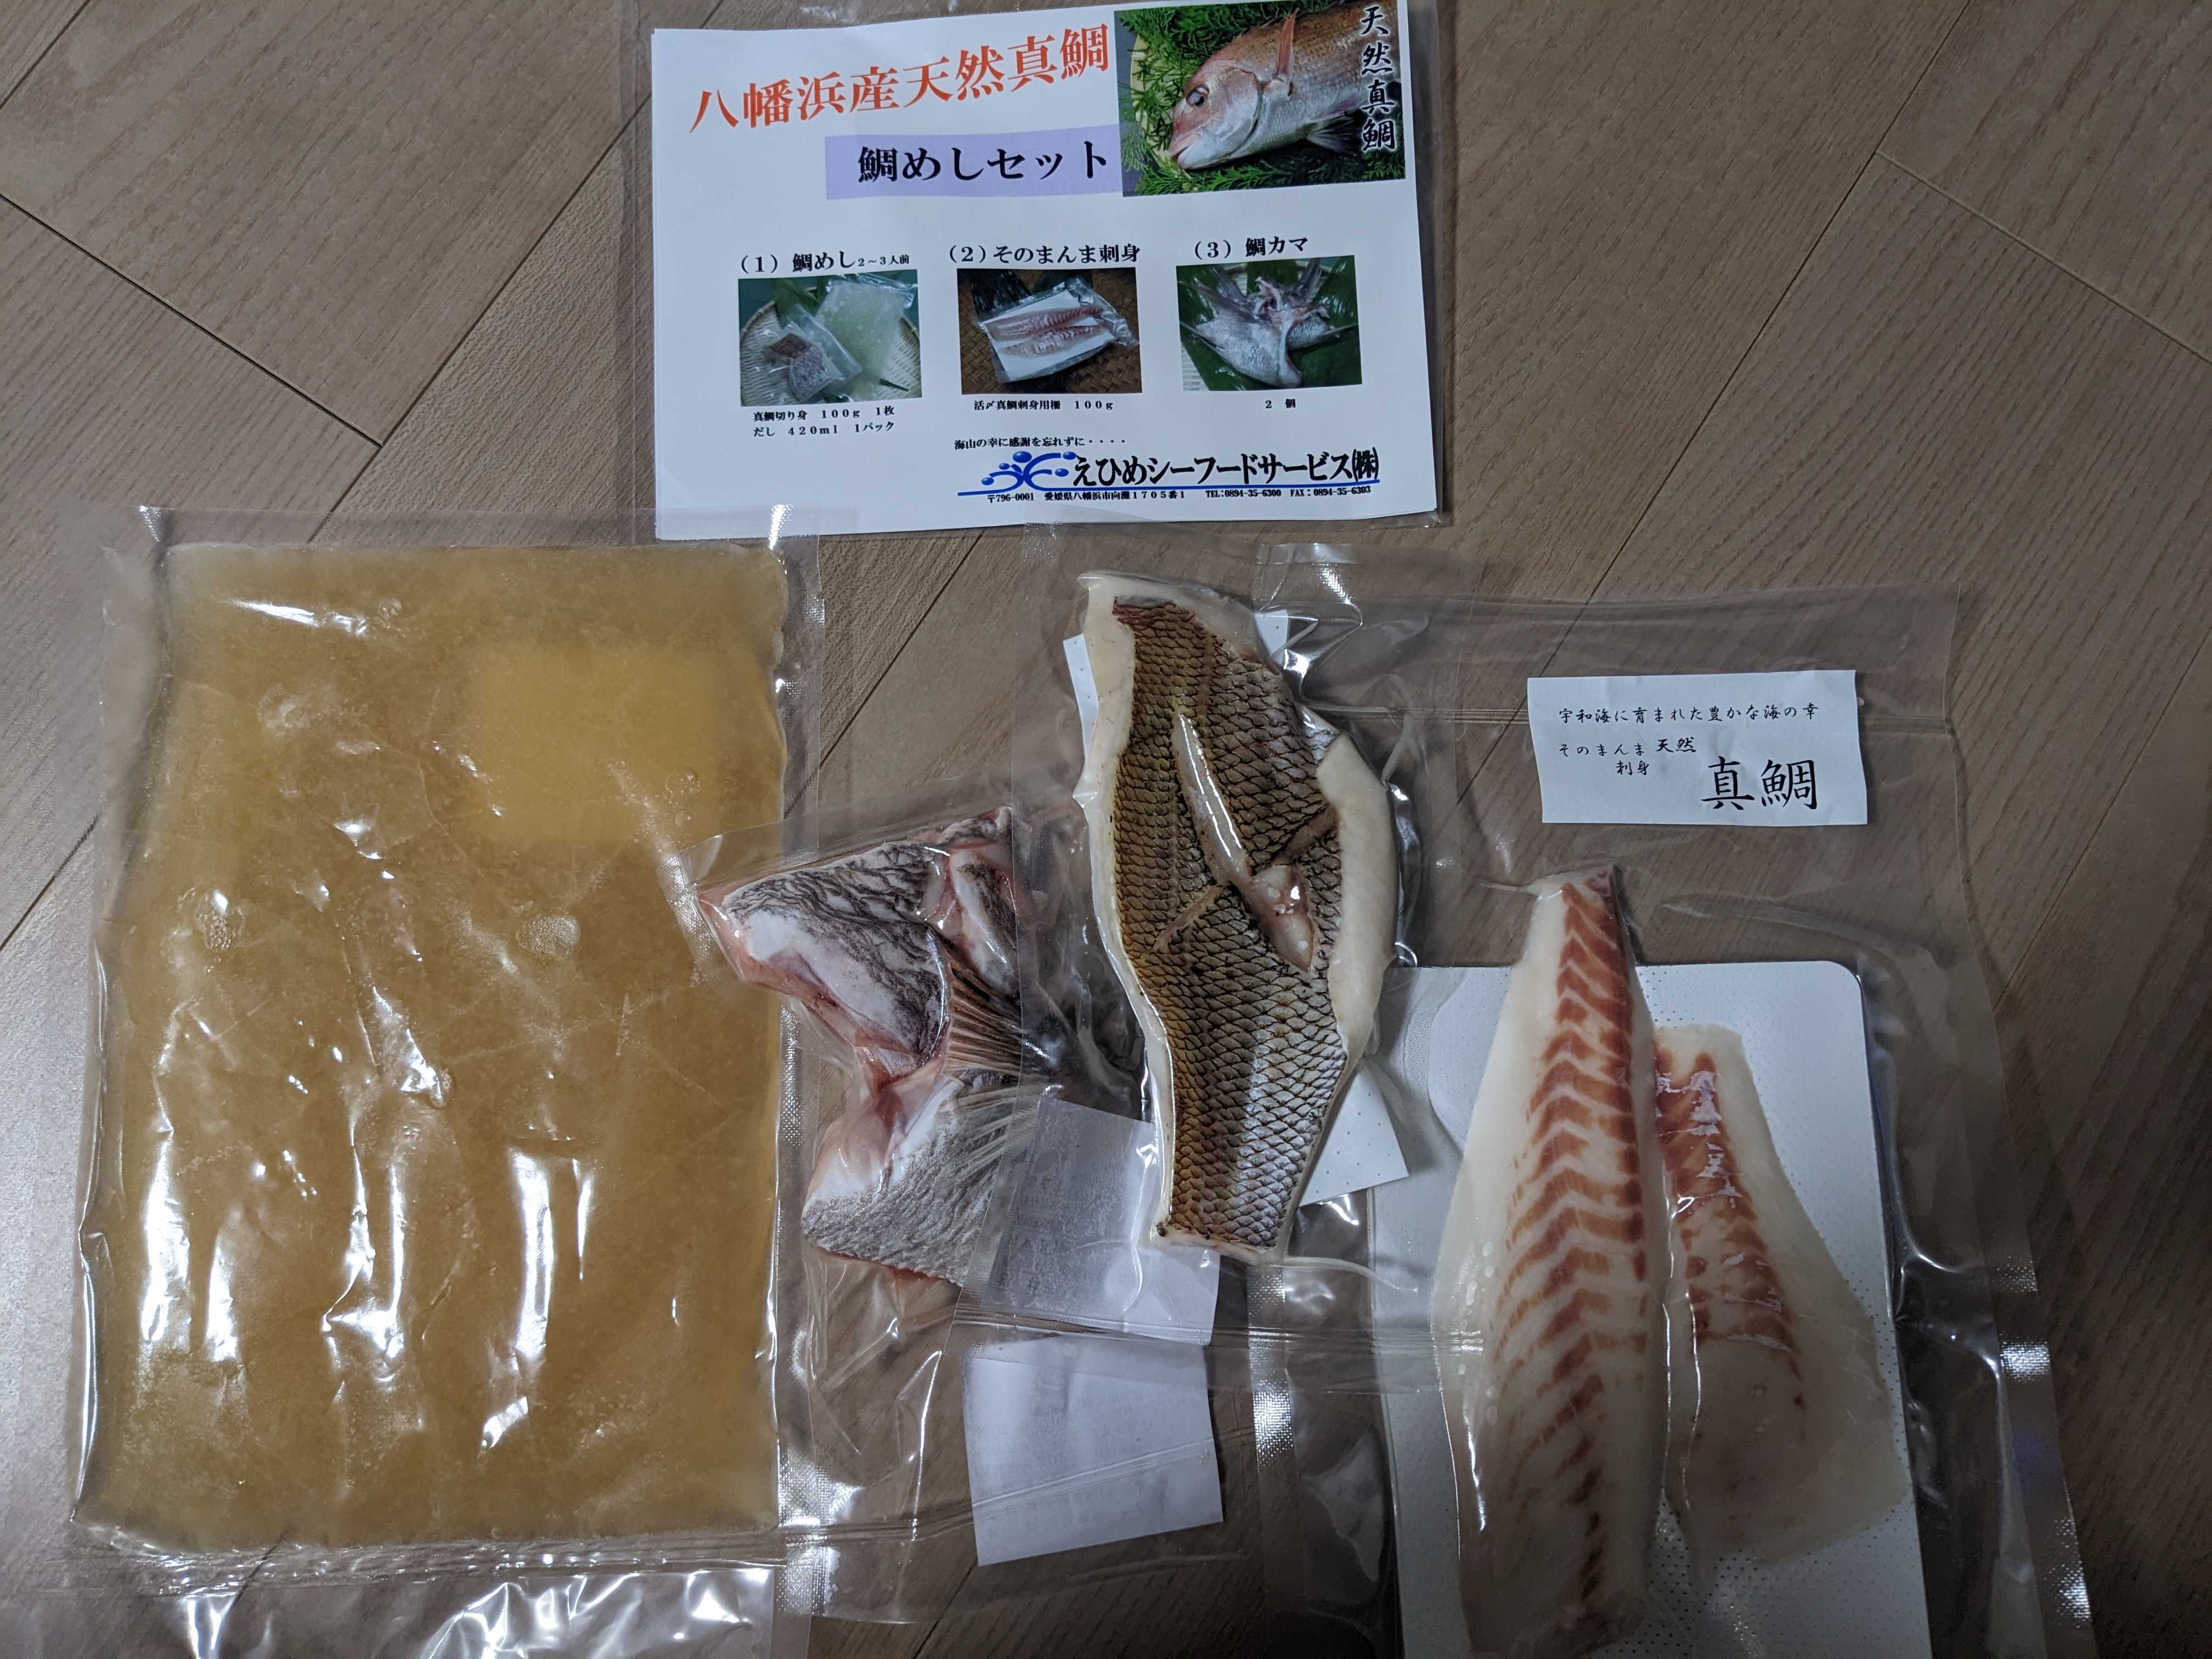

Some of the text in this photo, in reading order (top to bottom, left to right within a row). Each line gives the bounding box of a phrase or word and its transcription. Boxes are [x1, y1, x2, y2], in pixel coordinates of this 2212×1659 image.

[689, 23, 1109, 132] 八幡浜産天然真鯛
[1359, 5, 1396, 152] 天然真鯛
[857, 140, 1107, 183] 鯛めしセット
[1194, 236, 1309, 260] (3) 鯛カマ
[741, 254, 778, 274] (1)
[1075, 400, 1113, 410] 100g
[1265, 400, 1272, 409] 2
[753, 405, 895, 422] 真鯛切り身 100g 1枚
[753, 421, 894, 437] だし 420ml 1パック
[1205, 489, 1282, 498] TEL:0894-35-6300
[1656, 736, 1696, 753] 天然
[1616, 760, 1650, 776] 刺身
[1701, 755, 1818, 810] 真鯛
